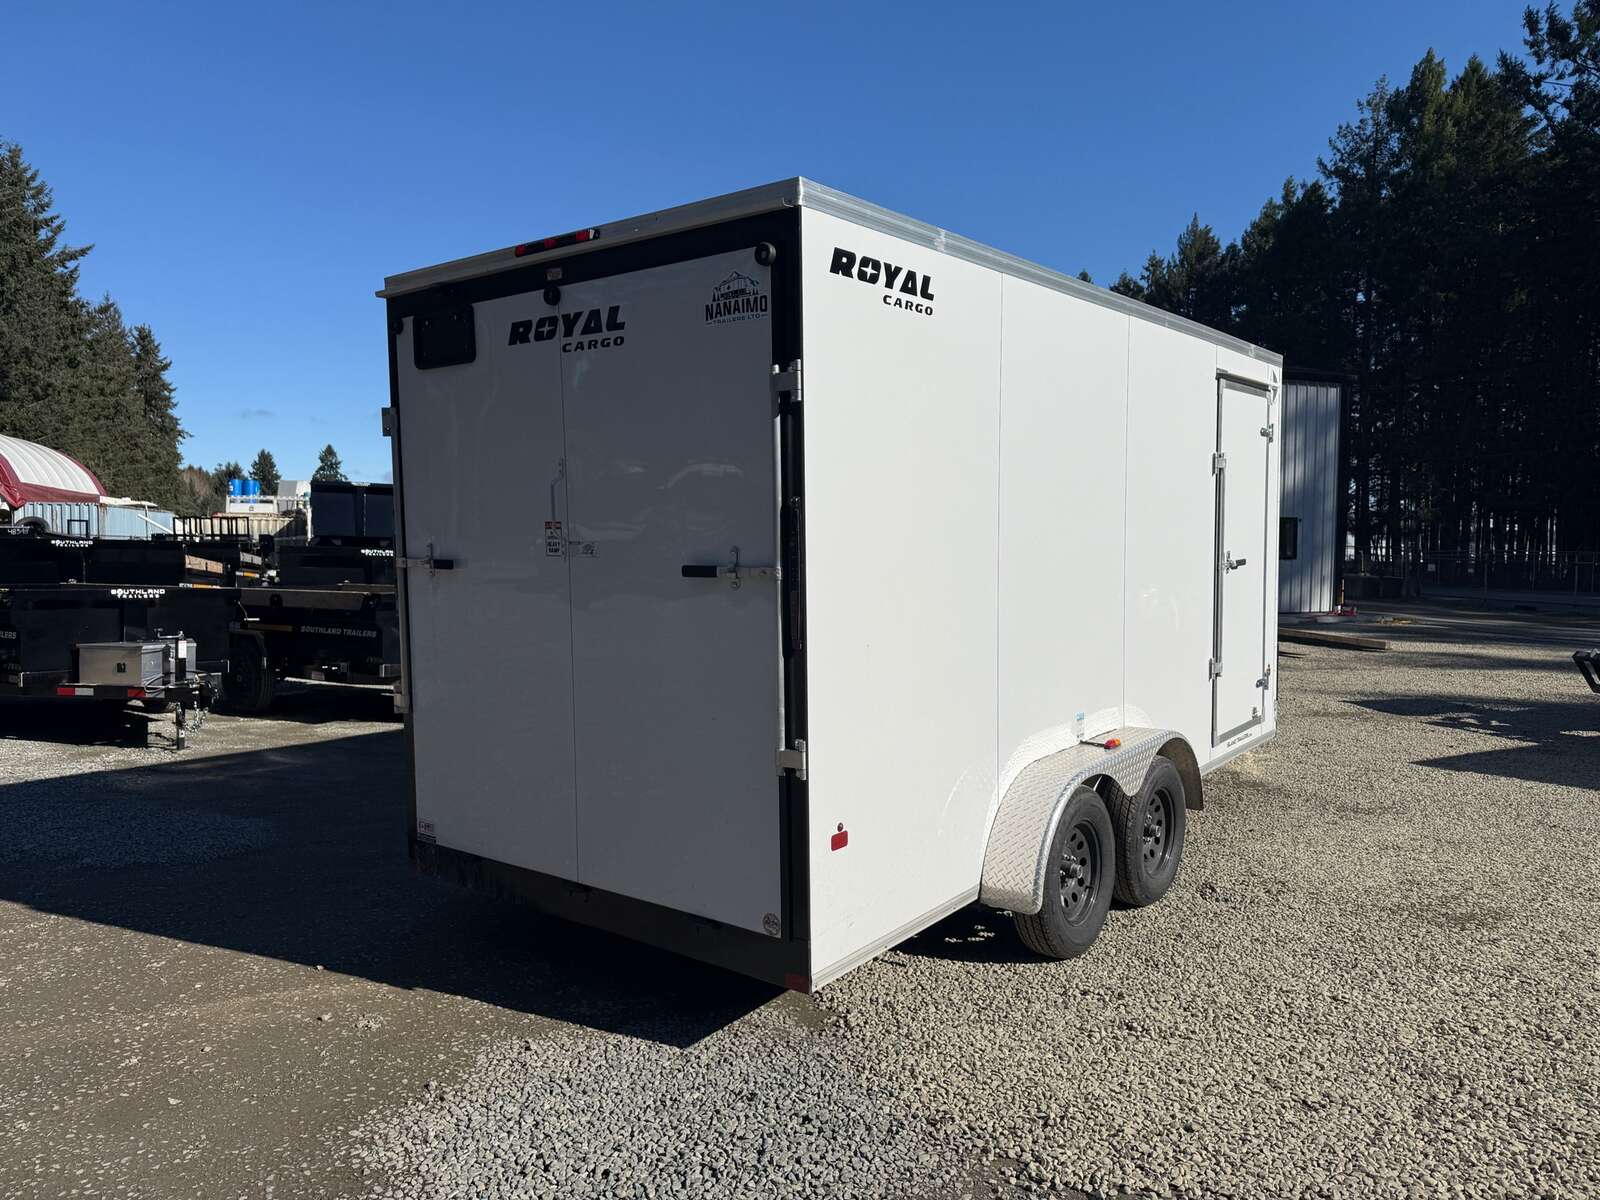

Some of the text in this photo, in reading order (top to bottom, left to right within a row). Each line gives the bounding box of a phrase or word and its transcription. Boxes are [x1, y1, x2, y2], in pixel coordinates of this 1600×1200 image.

[829, 247, 935, 301] ROYAL
[705, 295, 768, 321] NANAIMO
[883, 294, 934, 316] CARGO
[508, 305, 626, 346] ROYAL
[712, 312, 761, 324] TRAILERS LTD
[562, 336, 625, 353] CARGO
[301, 626, 377, 638] SOUTHLAND TRAILERS
